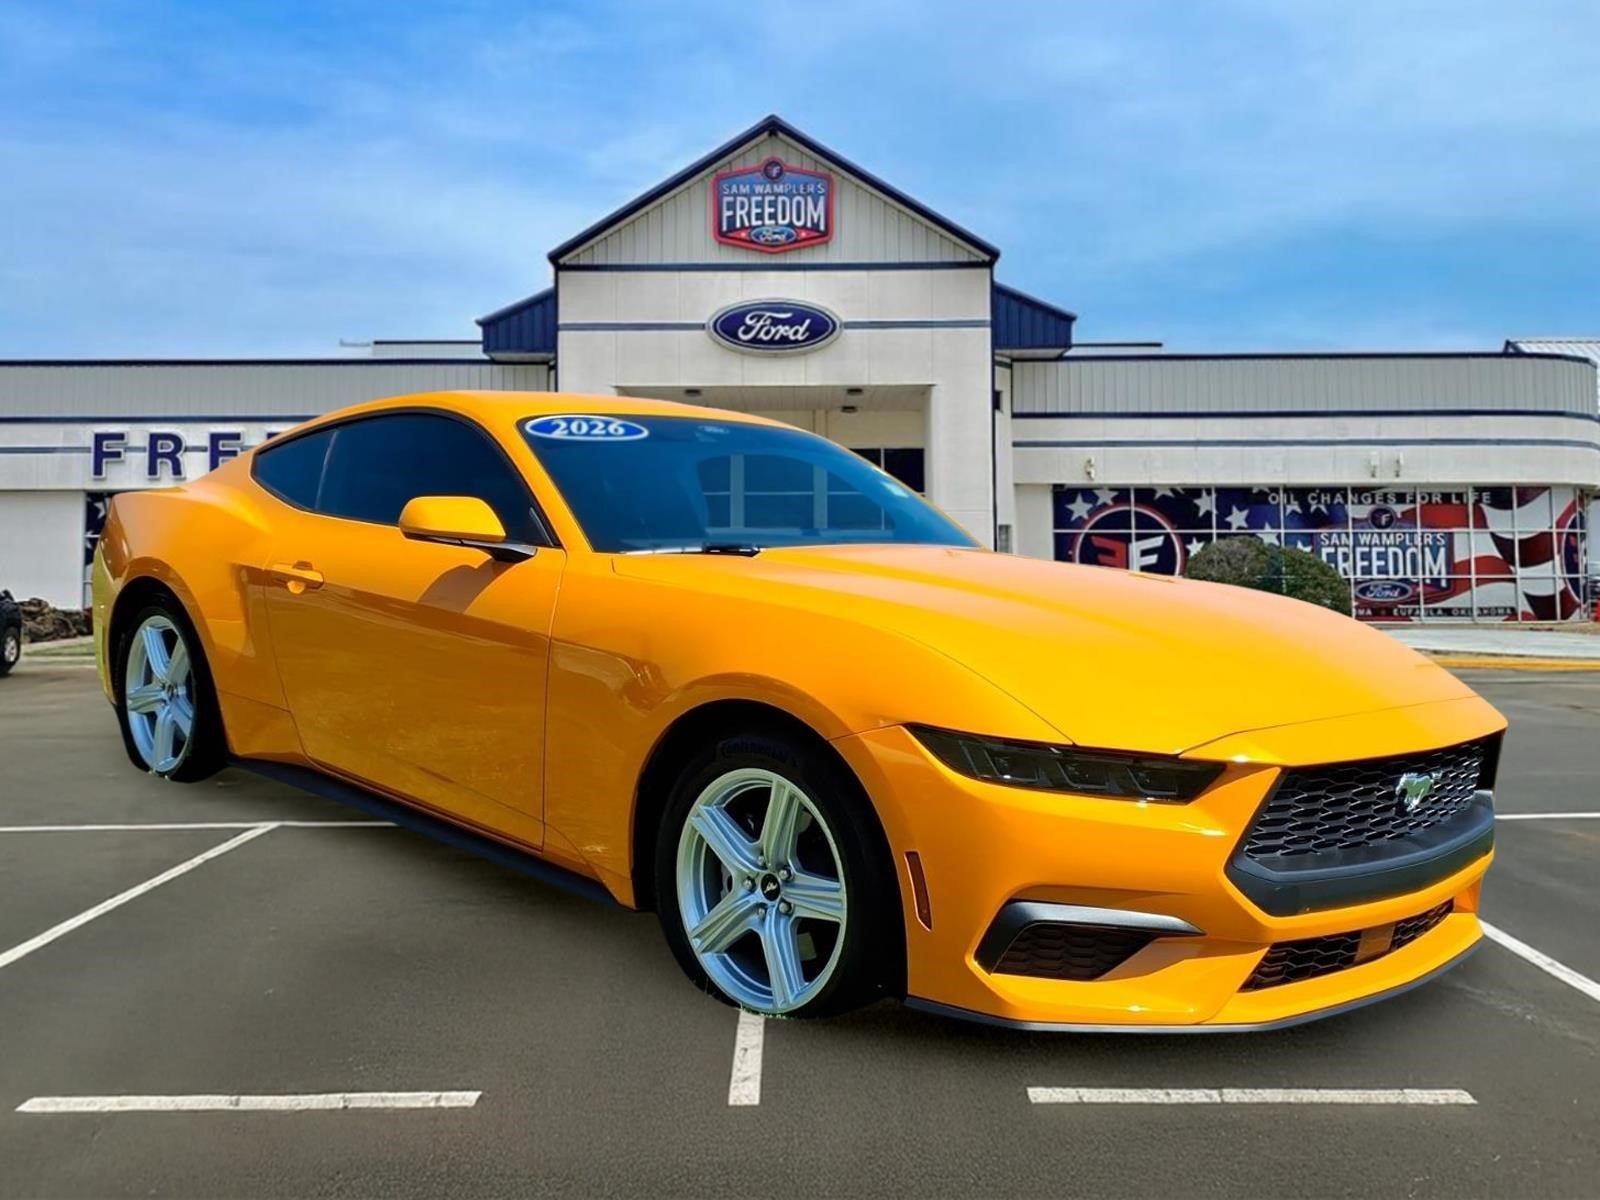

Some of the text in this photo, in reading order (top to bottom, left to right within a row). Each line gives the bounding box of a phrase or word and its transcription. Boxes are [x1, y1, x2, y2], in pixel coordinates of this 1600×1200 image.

[722, 183, 750, 195] SAM
[721, 196, 825, 231] FREEDOM
[737, 310, 811, 341] Ford
[551, 418, 626, 436] 2026
[92, 430, 286, 479] FRE
[1268, 492, 1492, 505] OIL CHANGES FOR LIFE
[1321, 547, 1447, 588] FREEDOM
[1365, 584, 1401, 598] Ford
